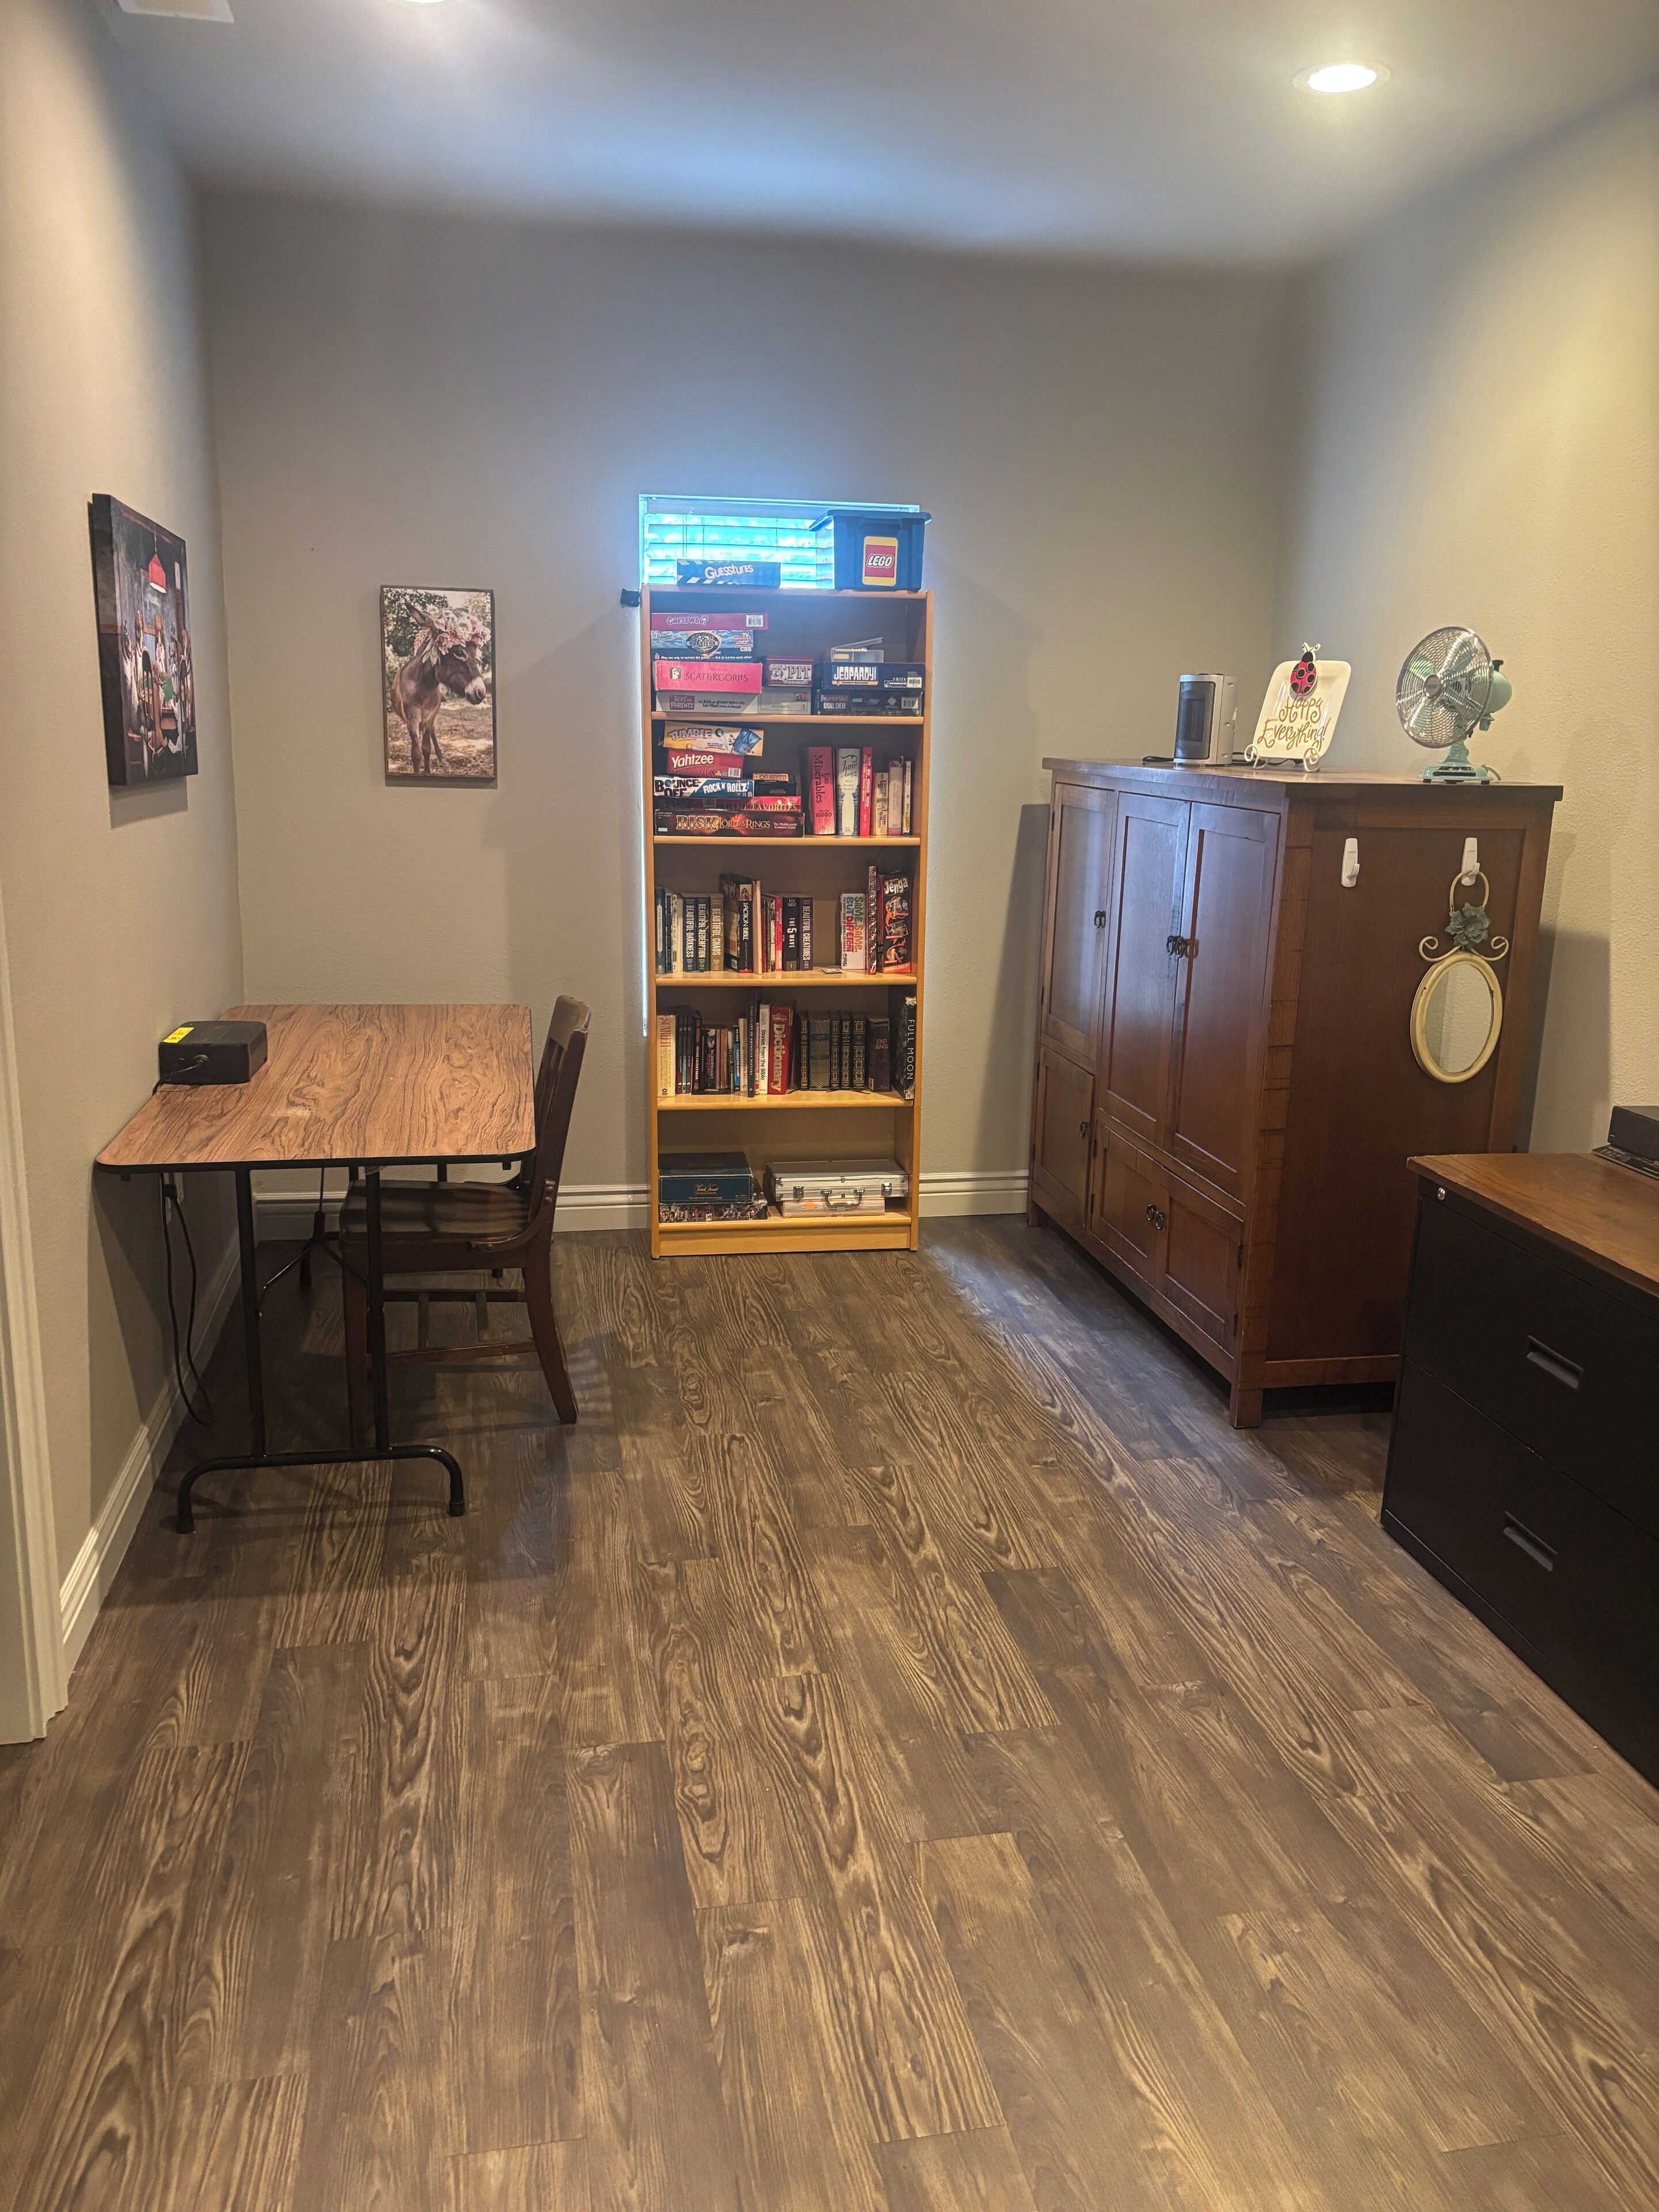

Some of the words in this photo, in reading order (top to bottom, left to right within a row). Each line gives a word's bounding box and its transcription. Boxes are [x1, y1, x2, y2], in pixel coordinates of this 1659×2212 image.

[867, 554, 893, 568] LEGO
[685, 672, 748, 682] SCATTERGORIES
[787, 665, 810, 680] PIT
[834, 666, 876, 681] JEOPARDY!
[1279, 696, 1323, 723] Happy
[668, 728, 712, 741] TUMBLE
[1257, 718, 1332, 752] Everything!
[672, 754, 714, 768] Yahtzee
[703, 782, 721, 794] ROCK
[814, 755, 825, 803] Misérables
[751, 801, 797, 811] FAVORITES
[676, 815, 719, 830] RISK
[746, 819, 770, 830] RINGS
[884, 877, 908, 894] Jenga
[686, 906, 694, 931] BEAUTIFUL
[698, 904, 706, 929] BEAUTIFUL
[712, 908, 721, 937] BEAUTIFUL
[686, 933, 694, 958] DARKNESS
[698, 930, 706, 958] REDEMPTION
[712, 938, 721, 956] CHAOS
[659, 1018, 671, 1047] SCARLETT
[907, 1019, 915, 1043] FULL
[770, 1024, 786, 1092] Dictionary
